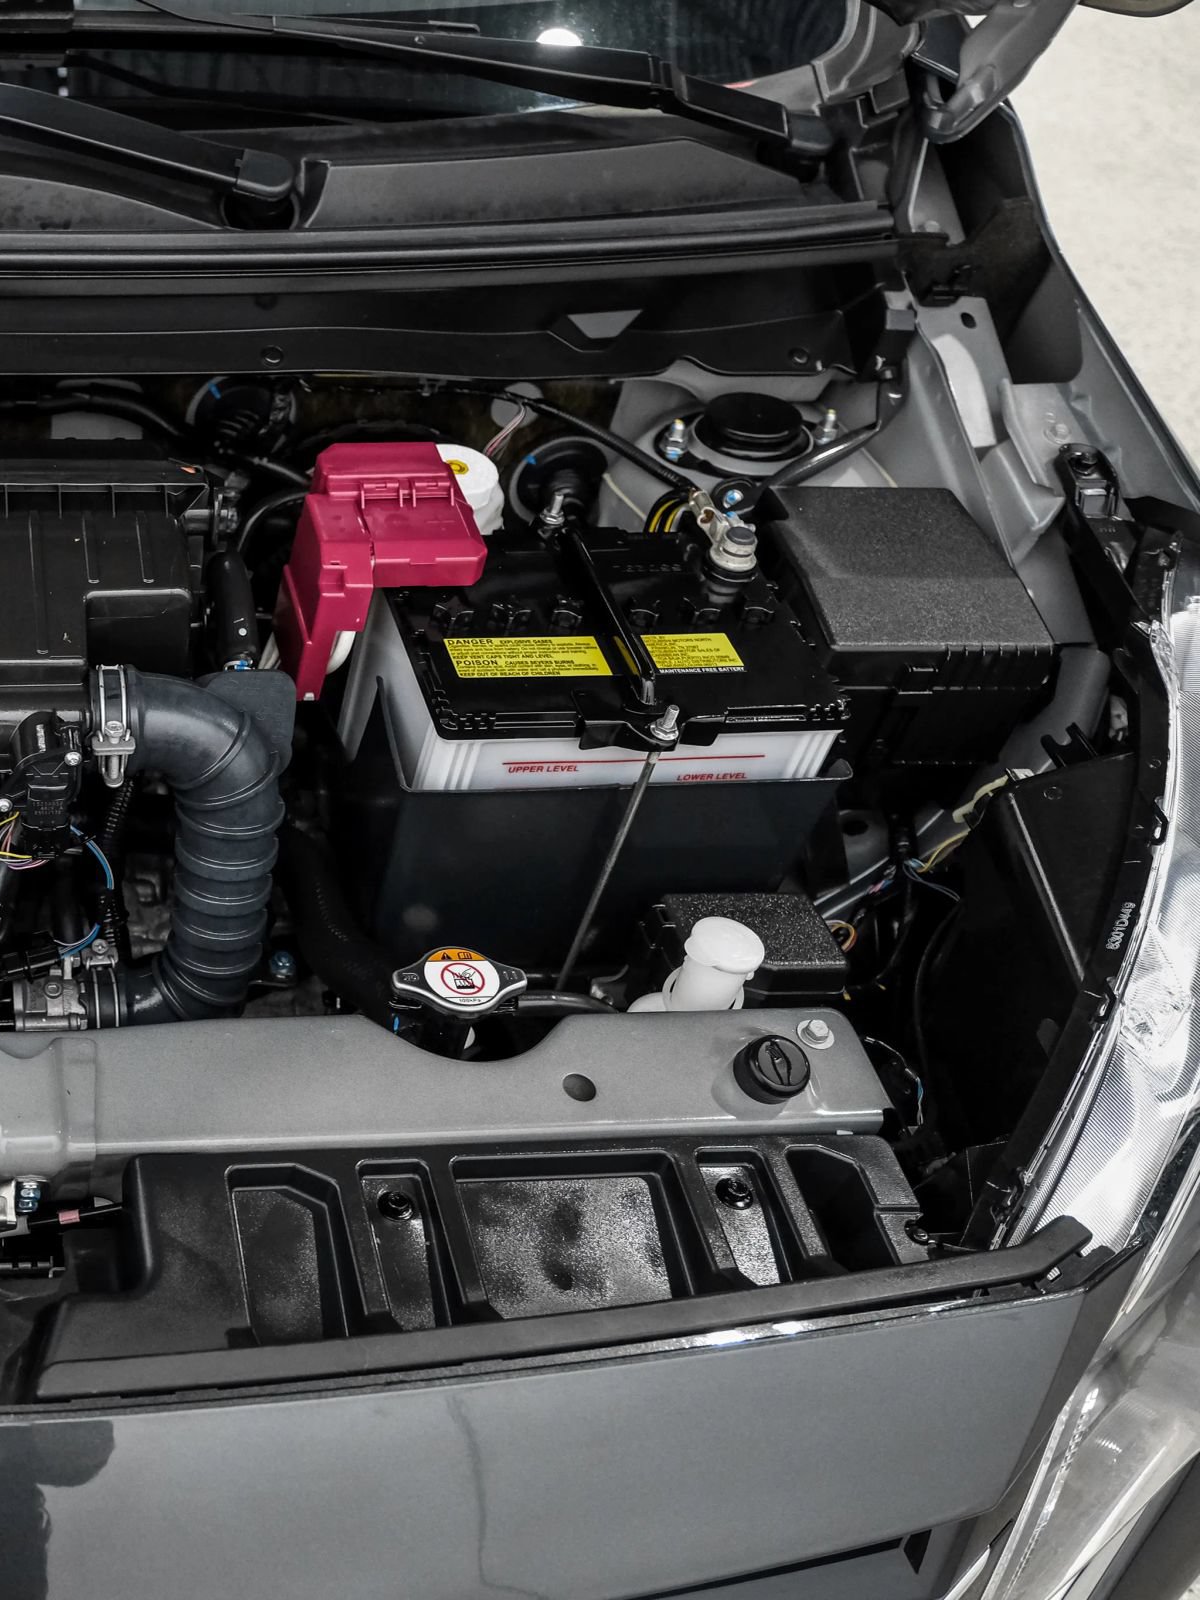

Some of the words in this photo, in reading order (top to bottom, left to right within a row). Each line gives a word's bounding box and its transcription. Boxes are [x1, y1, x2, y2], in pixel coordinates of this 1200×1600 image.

[508, 765, 544, 773] UPPER
[676, 773, 713, 781] LOWER
[716, 772, 748, 780] LEVEL
